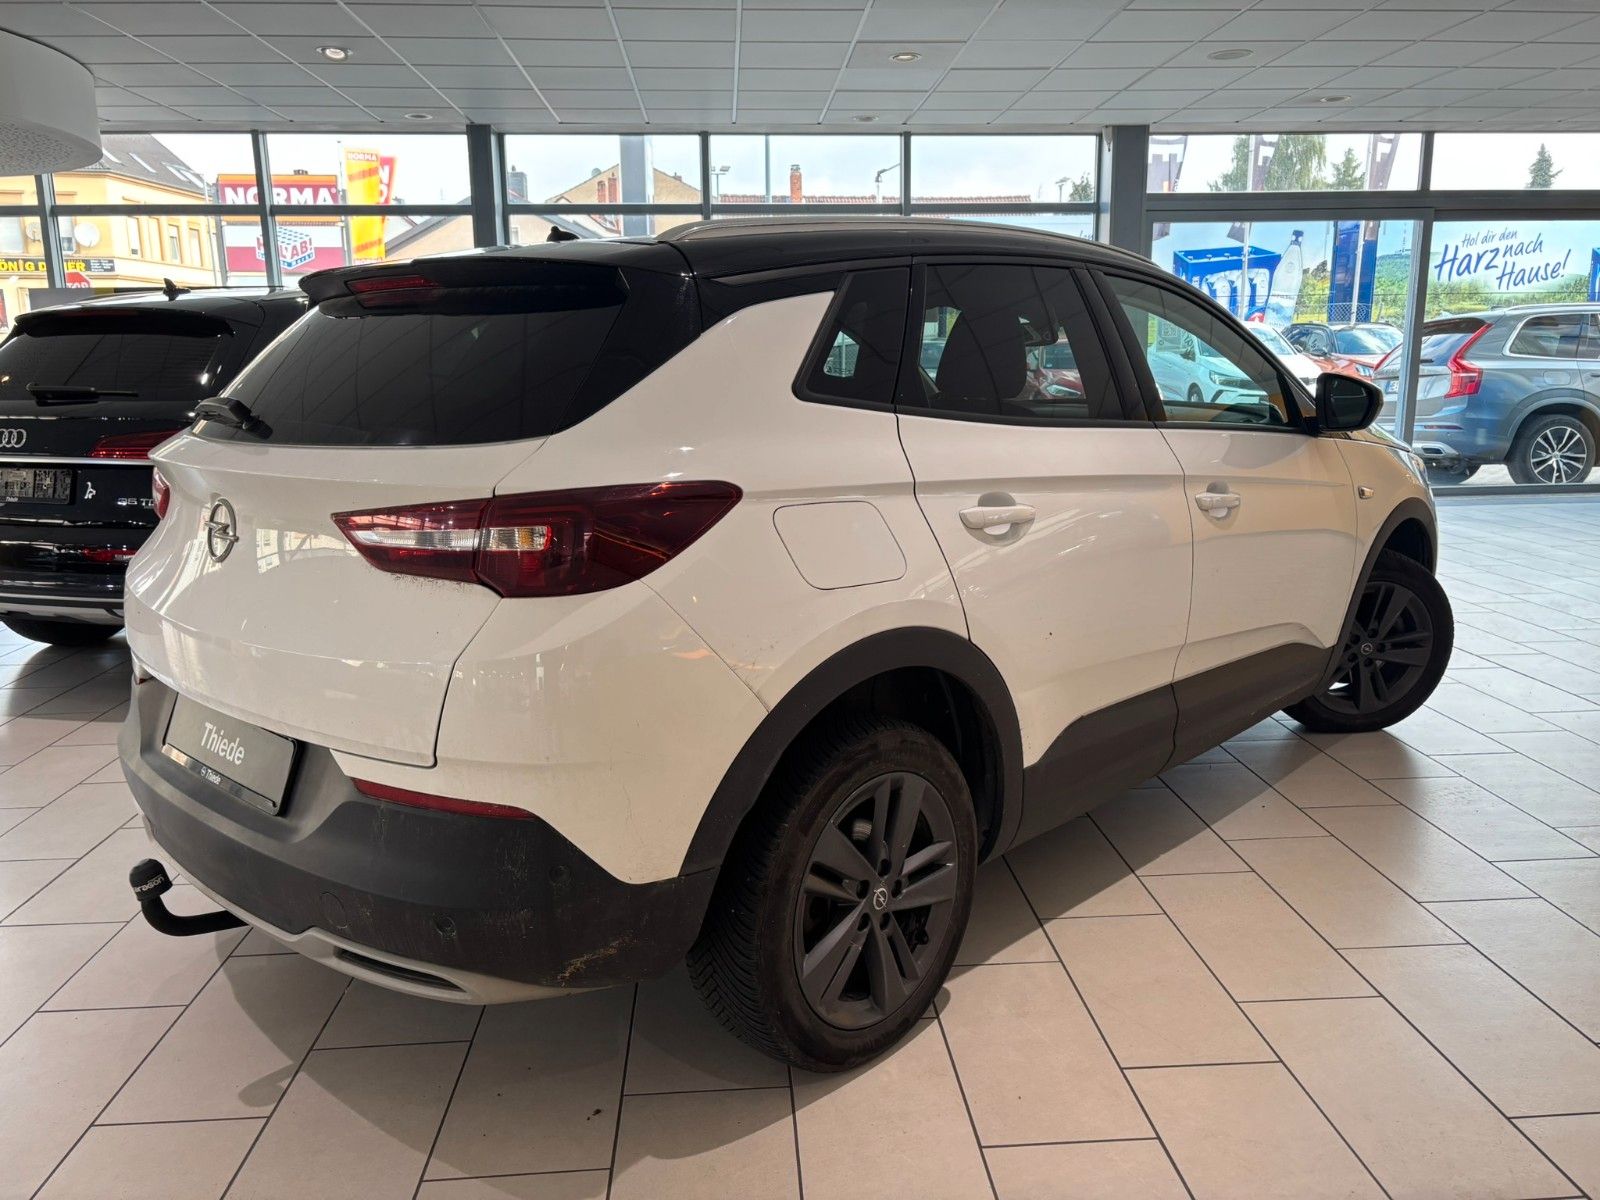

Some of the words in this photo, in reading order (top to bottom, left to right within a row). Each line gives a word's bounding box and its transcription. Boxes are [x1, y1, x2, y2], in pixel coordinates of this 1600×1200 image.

[224, 187, 333, 205] NORMA
[1462, 234, 1478, 248] Hol
[1481, 230, 1496, 245] dir
[1499, 227, 1518, 242] den
[0, 259, 35, 272] ÖNIG
[1434, 243, 1500, 282] Harz
[1502, 232, 1543, 258] nach
[1496, 248, 1571, 291] Hause!
[200, 722, 245, 766] Thiede
[205, 769, 221, 786] Thiede
